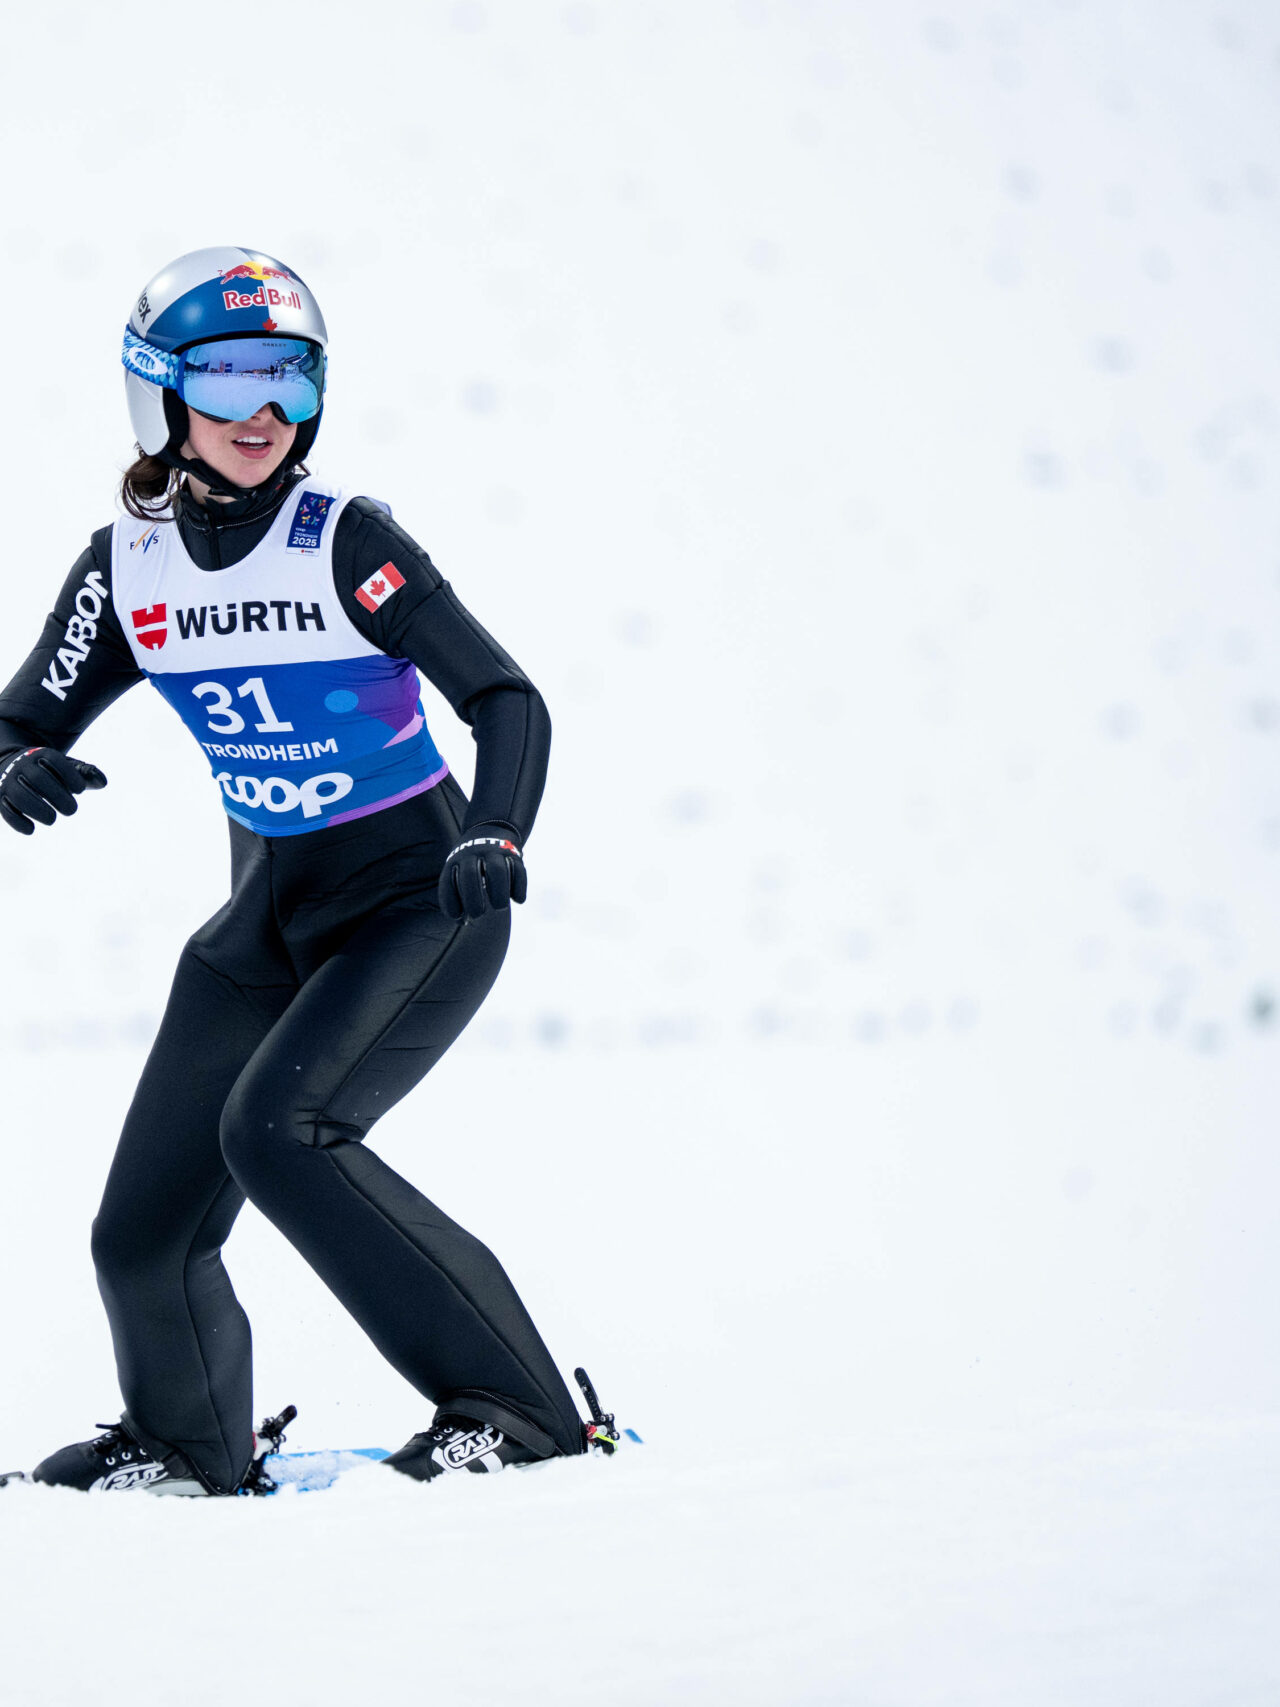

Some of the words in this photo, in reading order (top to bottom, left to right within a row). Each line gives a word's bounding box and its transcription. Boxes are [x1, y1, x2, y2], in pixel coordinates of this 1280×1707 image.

[223, 287, 266, 311] Red
[267, 288, 302, 311] Bull
[129, 531, 160, 552] FIS
[292, 536, 318, 547] 2025
[175, 600, 327, 640] WÜRTH
[191, 677, 294, 735] 31
[201, 738, 339, 761] TRONDHEIM
